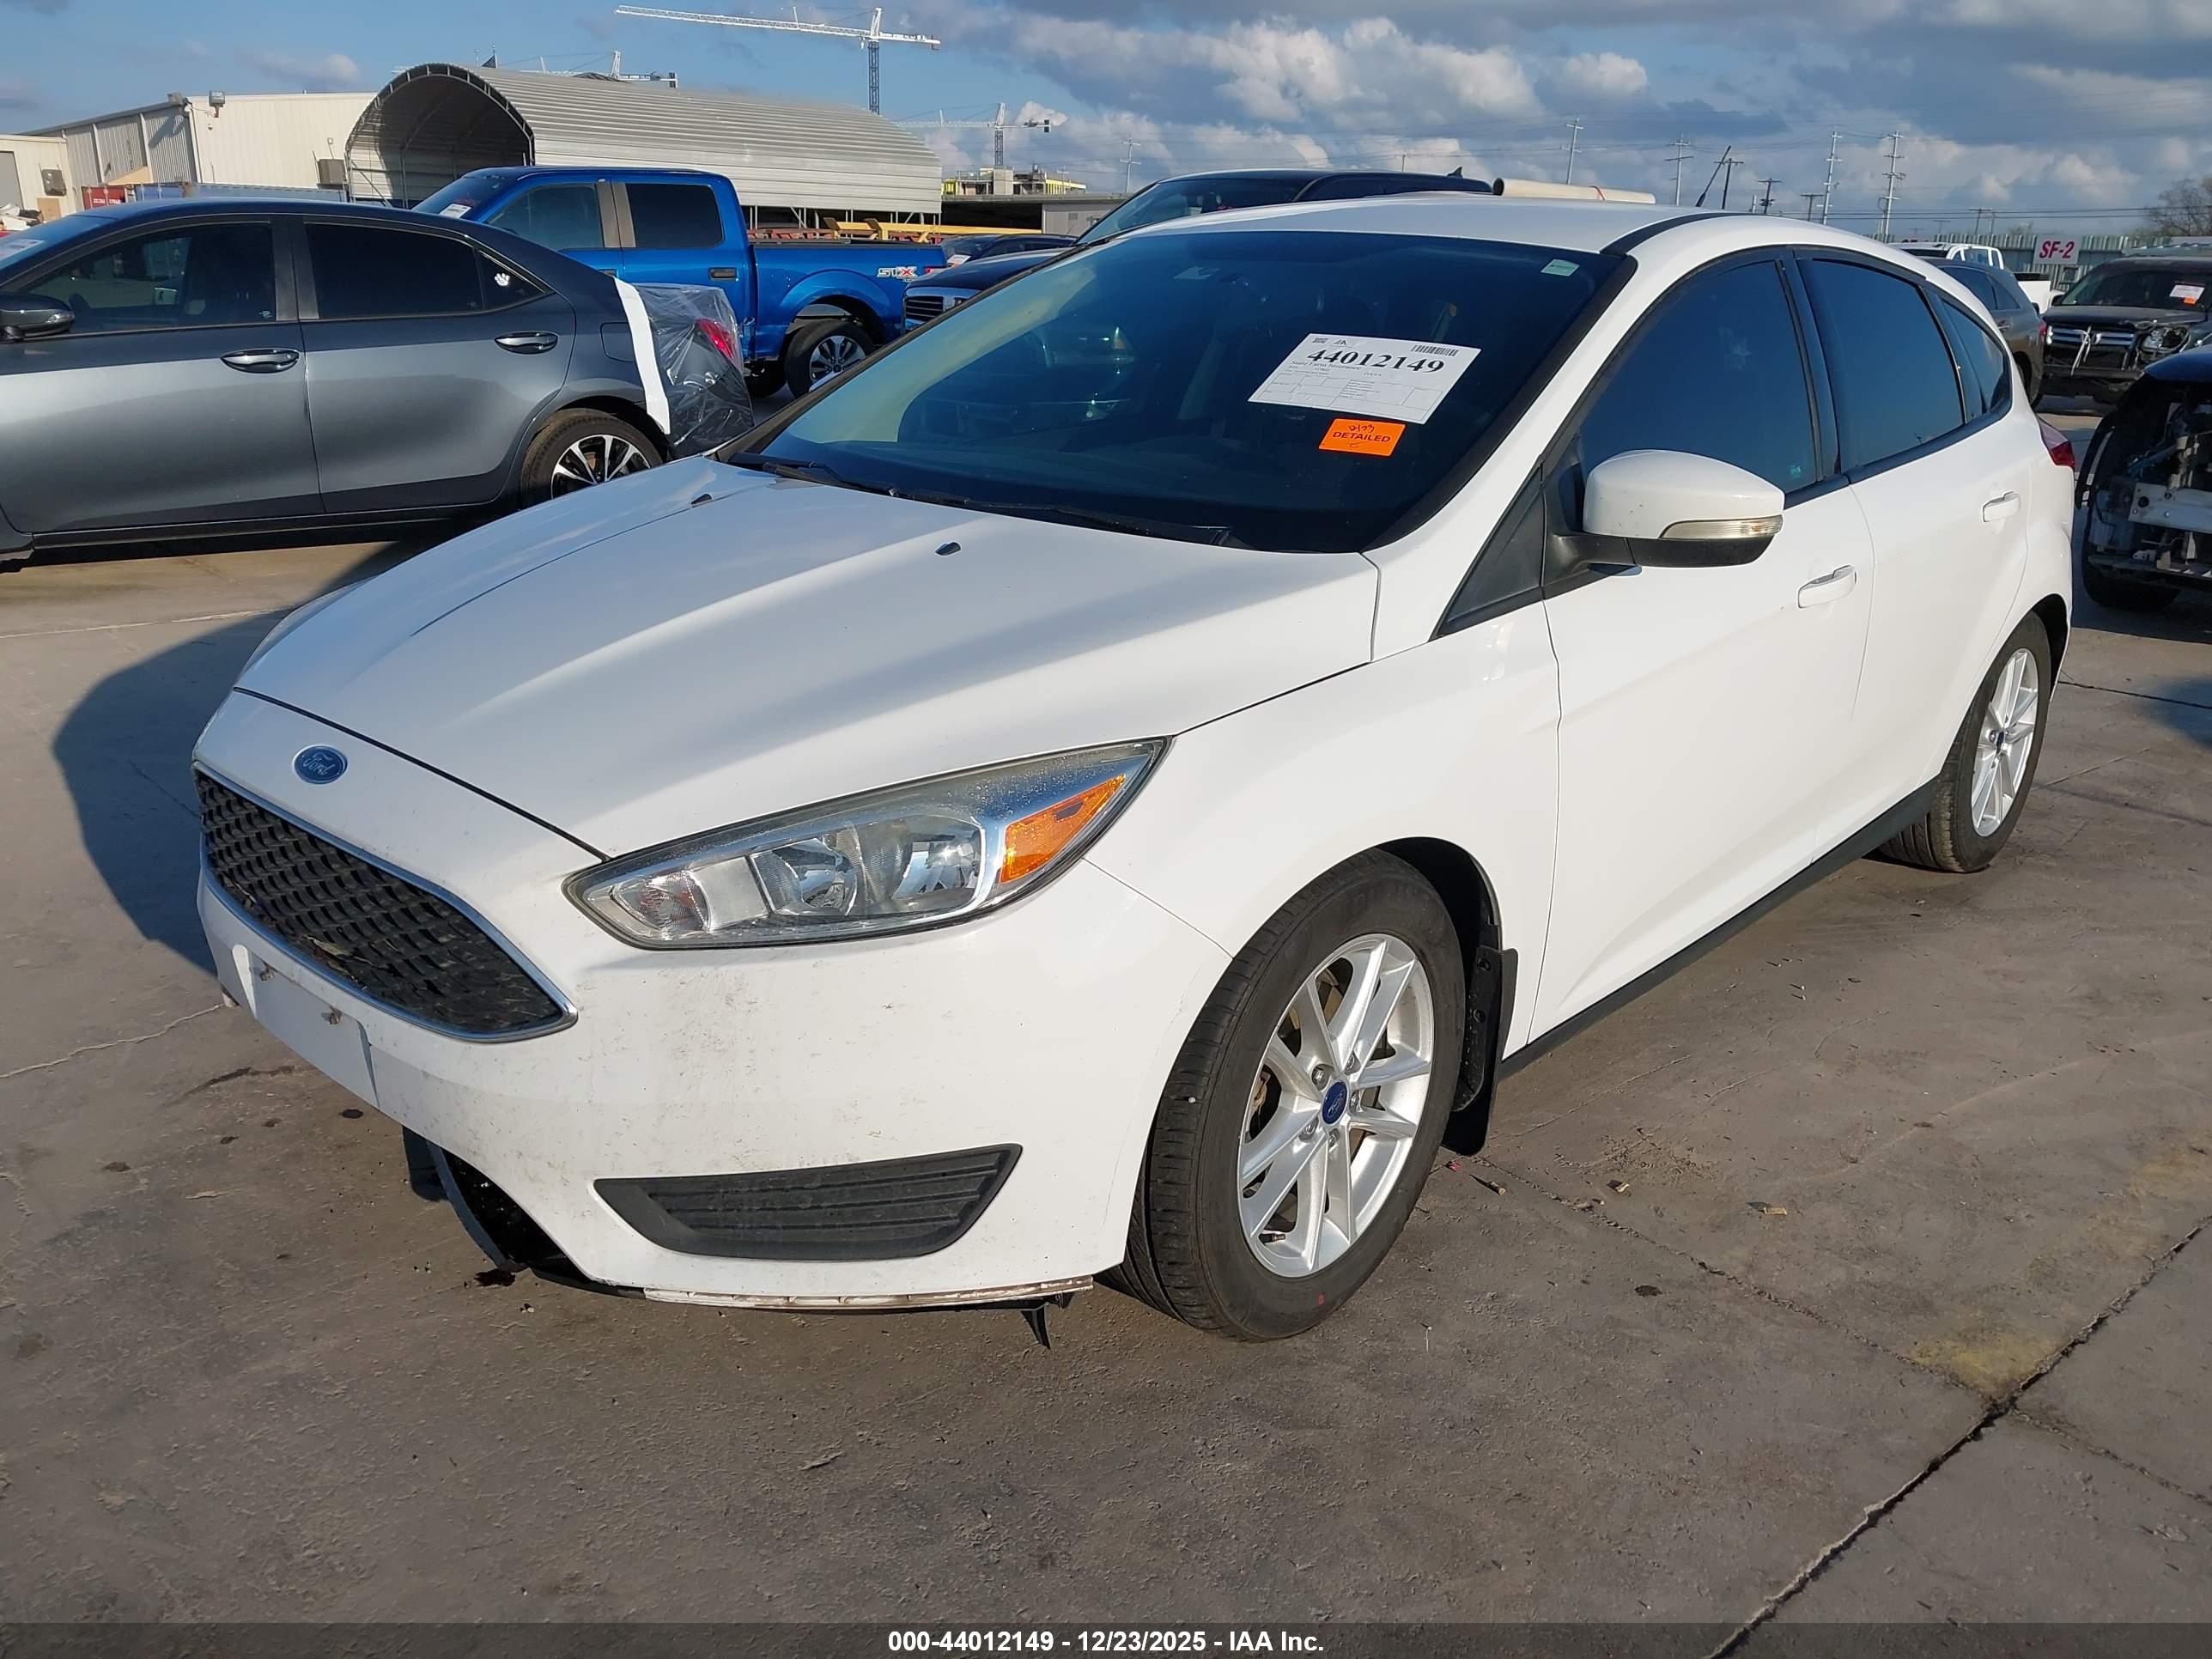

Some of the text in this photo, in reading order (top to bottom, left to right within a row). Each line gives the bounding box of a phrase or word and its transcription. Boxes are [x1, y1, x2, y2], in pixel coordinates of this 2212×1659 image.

[2039, 240, 2075, 259] SF-2
[1307, 349, 1445, 374] 44012149
[1332, 431, 1391, 442] DETAILED
[303, 752, 336, 775] Ford
